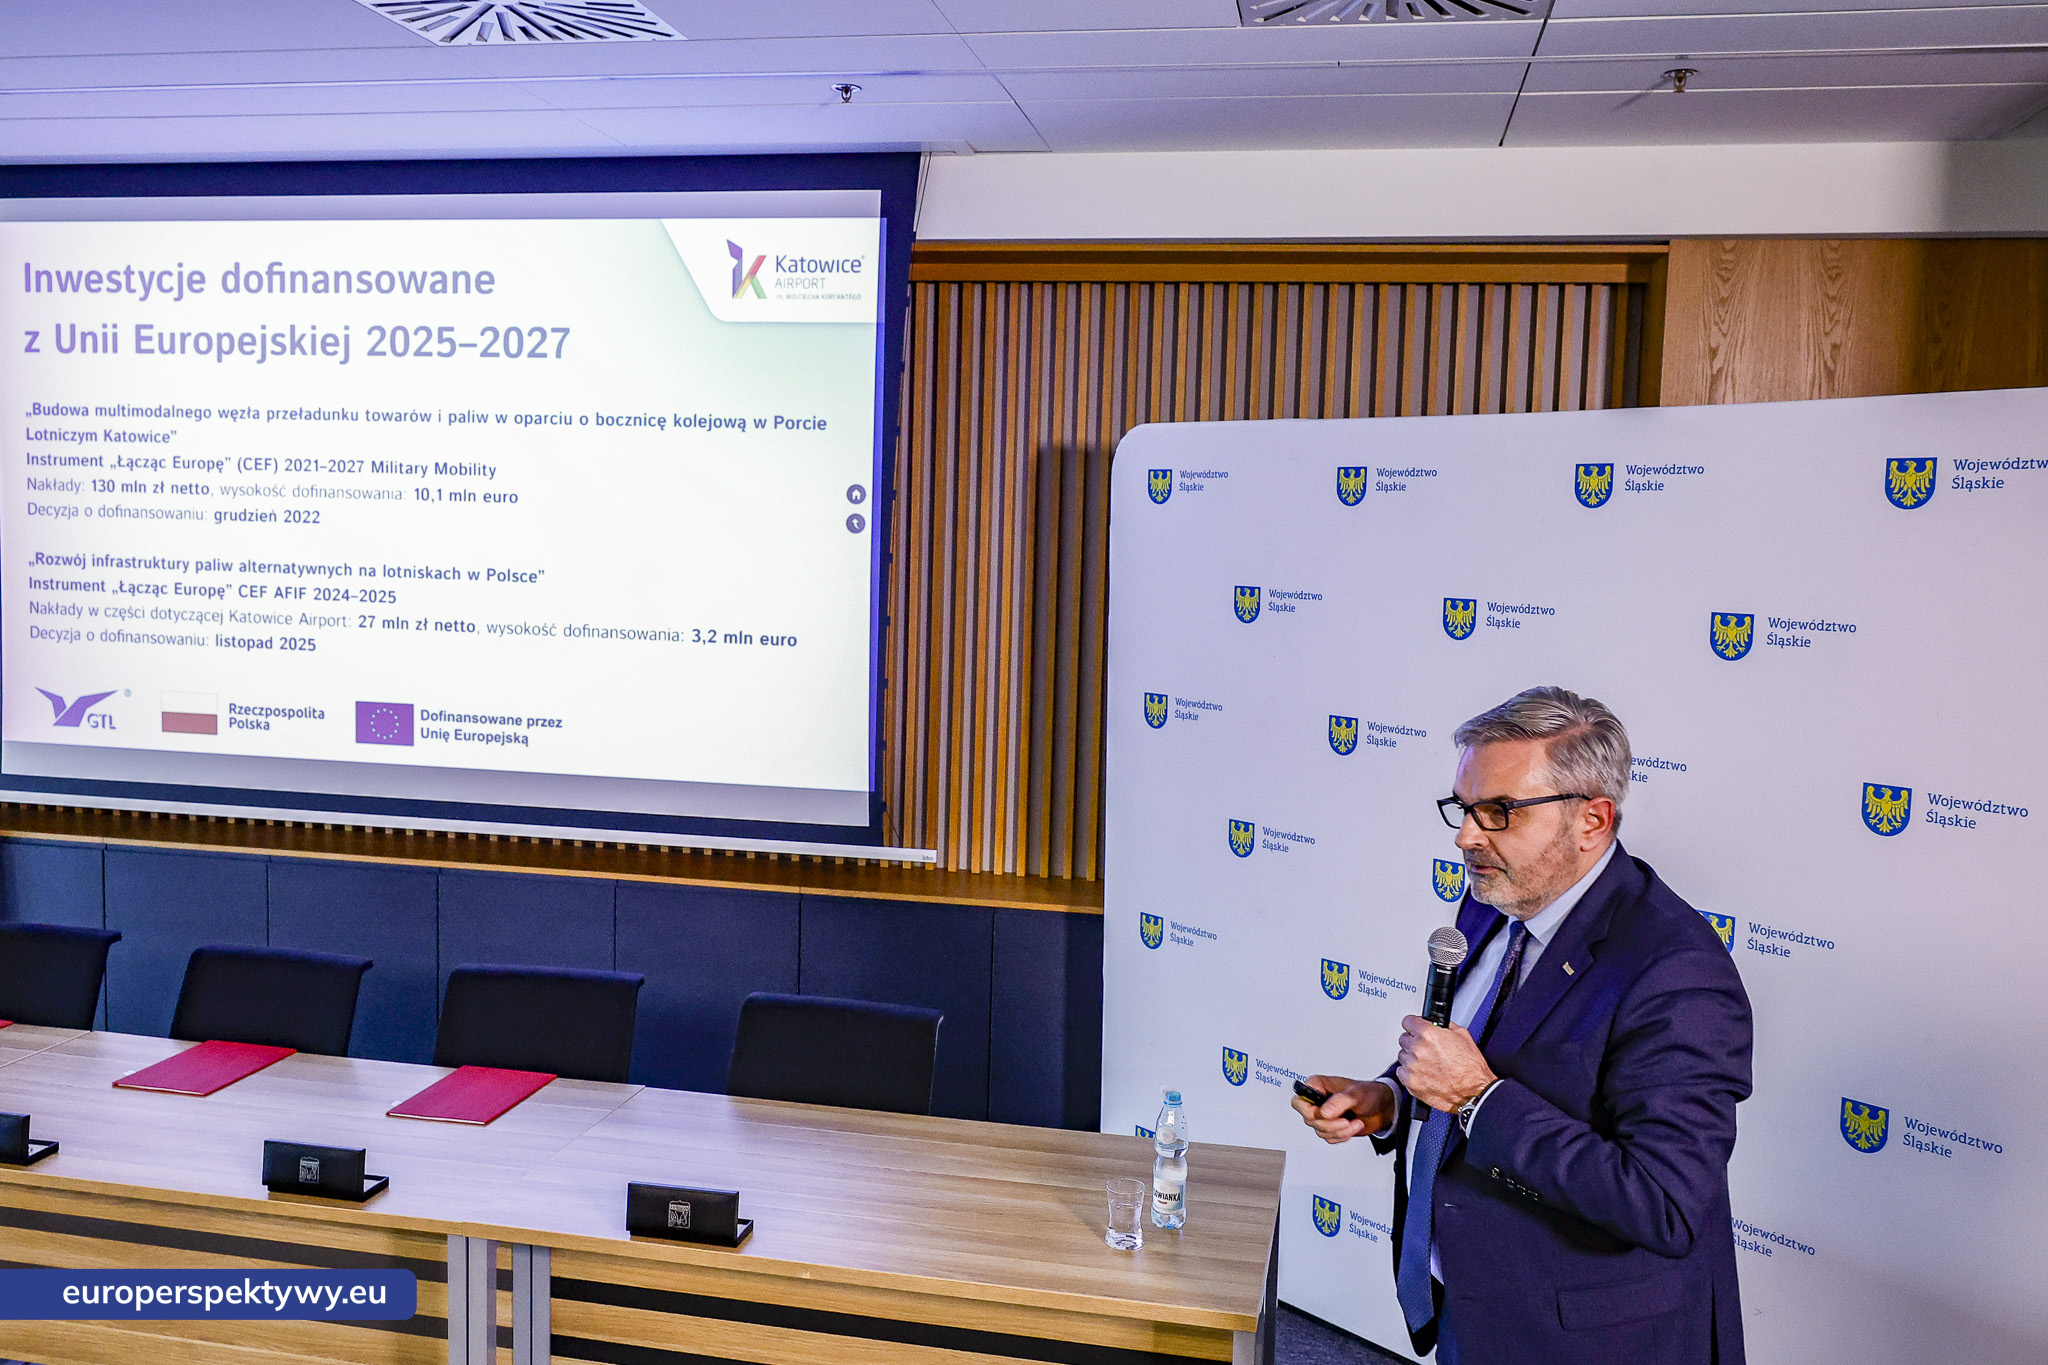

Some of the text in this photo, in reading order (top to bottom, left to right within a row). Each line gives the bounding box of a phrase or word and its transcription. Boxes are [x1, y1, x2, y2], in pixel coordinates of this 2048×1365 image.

[776, 255, 862, 273] Katowice
[24, 261, 495, 301] Inwestycje dofinansowane
[775, 278, 826, 289] AIRPORT
[24, 329, 40, 352] z
[55, 323, 119, 354] Unii
[134, 324, 351, 365] Europejskiej
[95, 404, 211, 422] multimodalnego
[218, 406, 259, 423] węzła
[266, 406, 359, 424] przeładunku
[365, 408, 431, 423] towarów
[438, 409, 442, 423] i
[448, 410, 488, 426] paliw
[496, 414, 507, 424] w
[514, 412, 572, 428] oparciu
[579, 414, 588, 425] o
[596, 412, 666, 430] bocznicę
[674, 413, 746, 432] kolejową
[754, 418, 767, 430] w
[774, 415, 827, 431] Porcie
[26, 427, 97, 443] Lotniczym
[27, 453, 103, 468] Instrument
[238, 457, 278, 474] (CEF)
[371, 460, 428, 476] Military
[434, 462, 496, 479] Mobility
[1376, 467, 1437, 479] Województwo
[1626, 464, 1704, 476] Województwo
[1953, 457, 2048, 473] Województw
[1179, 470, 1228, 480] Województwo
[1952, 475, 2004, 492] Śląskie
[27, 477, 518, 504] Nakłady: 130 mln zł netto, wysokość dofinansowania: 10,1 mln euro
[1179, 481, 1204, 493] Śląskie
[1376, 480, 1406, 493] Śląskie
[1625, 480, 1664, 493] Śląskie
[27, 502, 320, 524] Decyzja o dofinansowaniu: grudzień 2022
[92, 554, 189, 573] infrastruktury
[195, 557, 233, 574] paliw
[239, 559, 352, 578] alternatywnych
[359, 565, 375, 577] na
[383, 564, 461, 581] lotniskach
[468, 570, 480, 581] w
[29, 577, 106, 593] Instrument
[239, 584, 267, 598] CEF
[274, 586, 306, 600] AFIF
[1269, 589, 1322, 601] Województwo
[1268, 602, 1296, 614] Śląskie
[1487, 602, 1555, 616] Województwo
[29, 601, 797, 647] Nakłady w części dotyczącej Katowice Airport: 27 mln zł netto, wysokość dofinansowania: 3,2 mln euro
[1486, 617, 1521, 630] Śląskie
[1768, 617, 1857, 634] Województwo
[30, 626, 316, 652] Decyzja o dofinansowaniu: listopad 2025
[1766, 633, 1811, 649] Śląskie
[229, 703, 325, 723] Rzeczpospolita
[1175, 697, 1223, 712] Województwo
[87, 713, 116, 730] GTL
[420, 709, 563, 731] Dofinansowane przez
[1175, 709, 1199, 722] Śląskie
[229, 717, 271, 732] Polska
[1367, 721, 1427, 737] Województwo
[420, 727, 529, 747] Unię Europejską
[1366, 734, 1397, 748] Śląskie
[1631, 757, 1687, 772] ewództwo
[1928, 793, 2029, 818] Województwo
[1926, 809, 1977, 830] Śląskie
[1262, 827, 1315, 844] Województwo
[1262, 839, 1289, 853] Śląskie
[1169, 932, 1194, 947] Śląskie
[1170, 921, 1217, 941] Województwo
[1748, 922, 1835, 951] Województwo
[1747, 938, 1791, 958] Śląskie
[1358, 969, 1417, 993] Województwo
[1358, 982, 1387, 1000] Śląskie
[1255, 1070, 1281, 1087] Śląskie
[1256, 1059, 1308, 1083] Województwo
[1904, 1116, 2003, 1154] Województwo
[1903, 1134, 1952, 1159] Śląskie
[1349, 1223, 1378, 1242] Śląskie
[1732, 1217, 1815, 1255] Województwo
